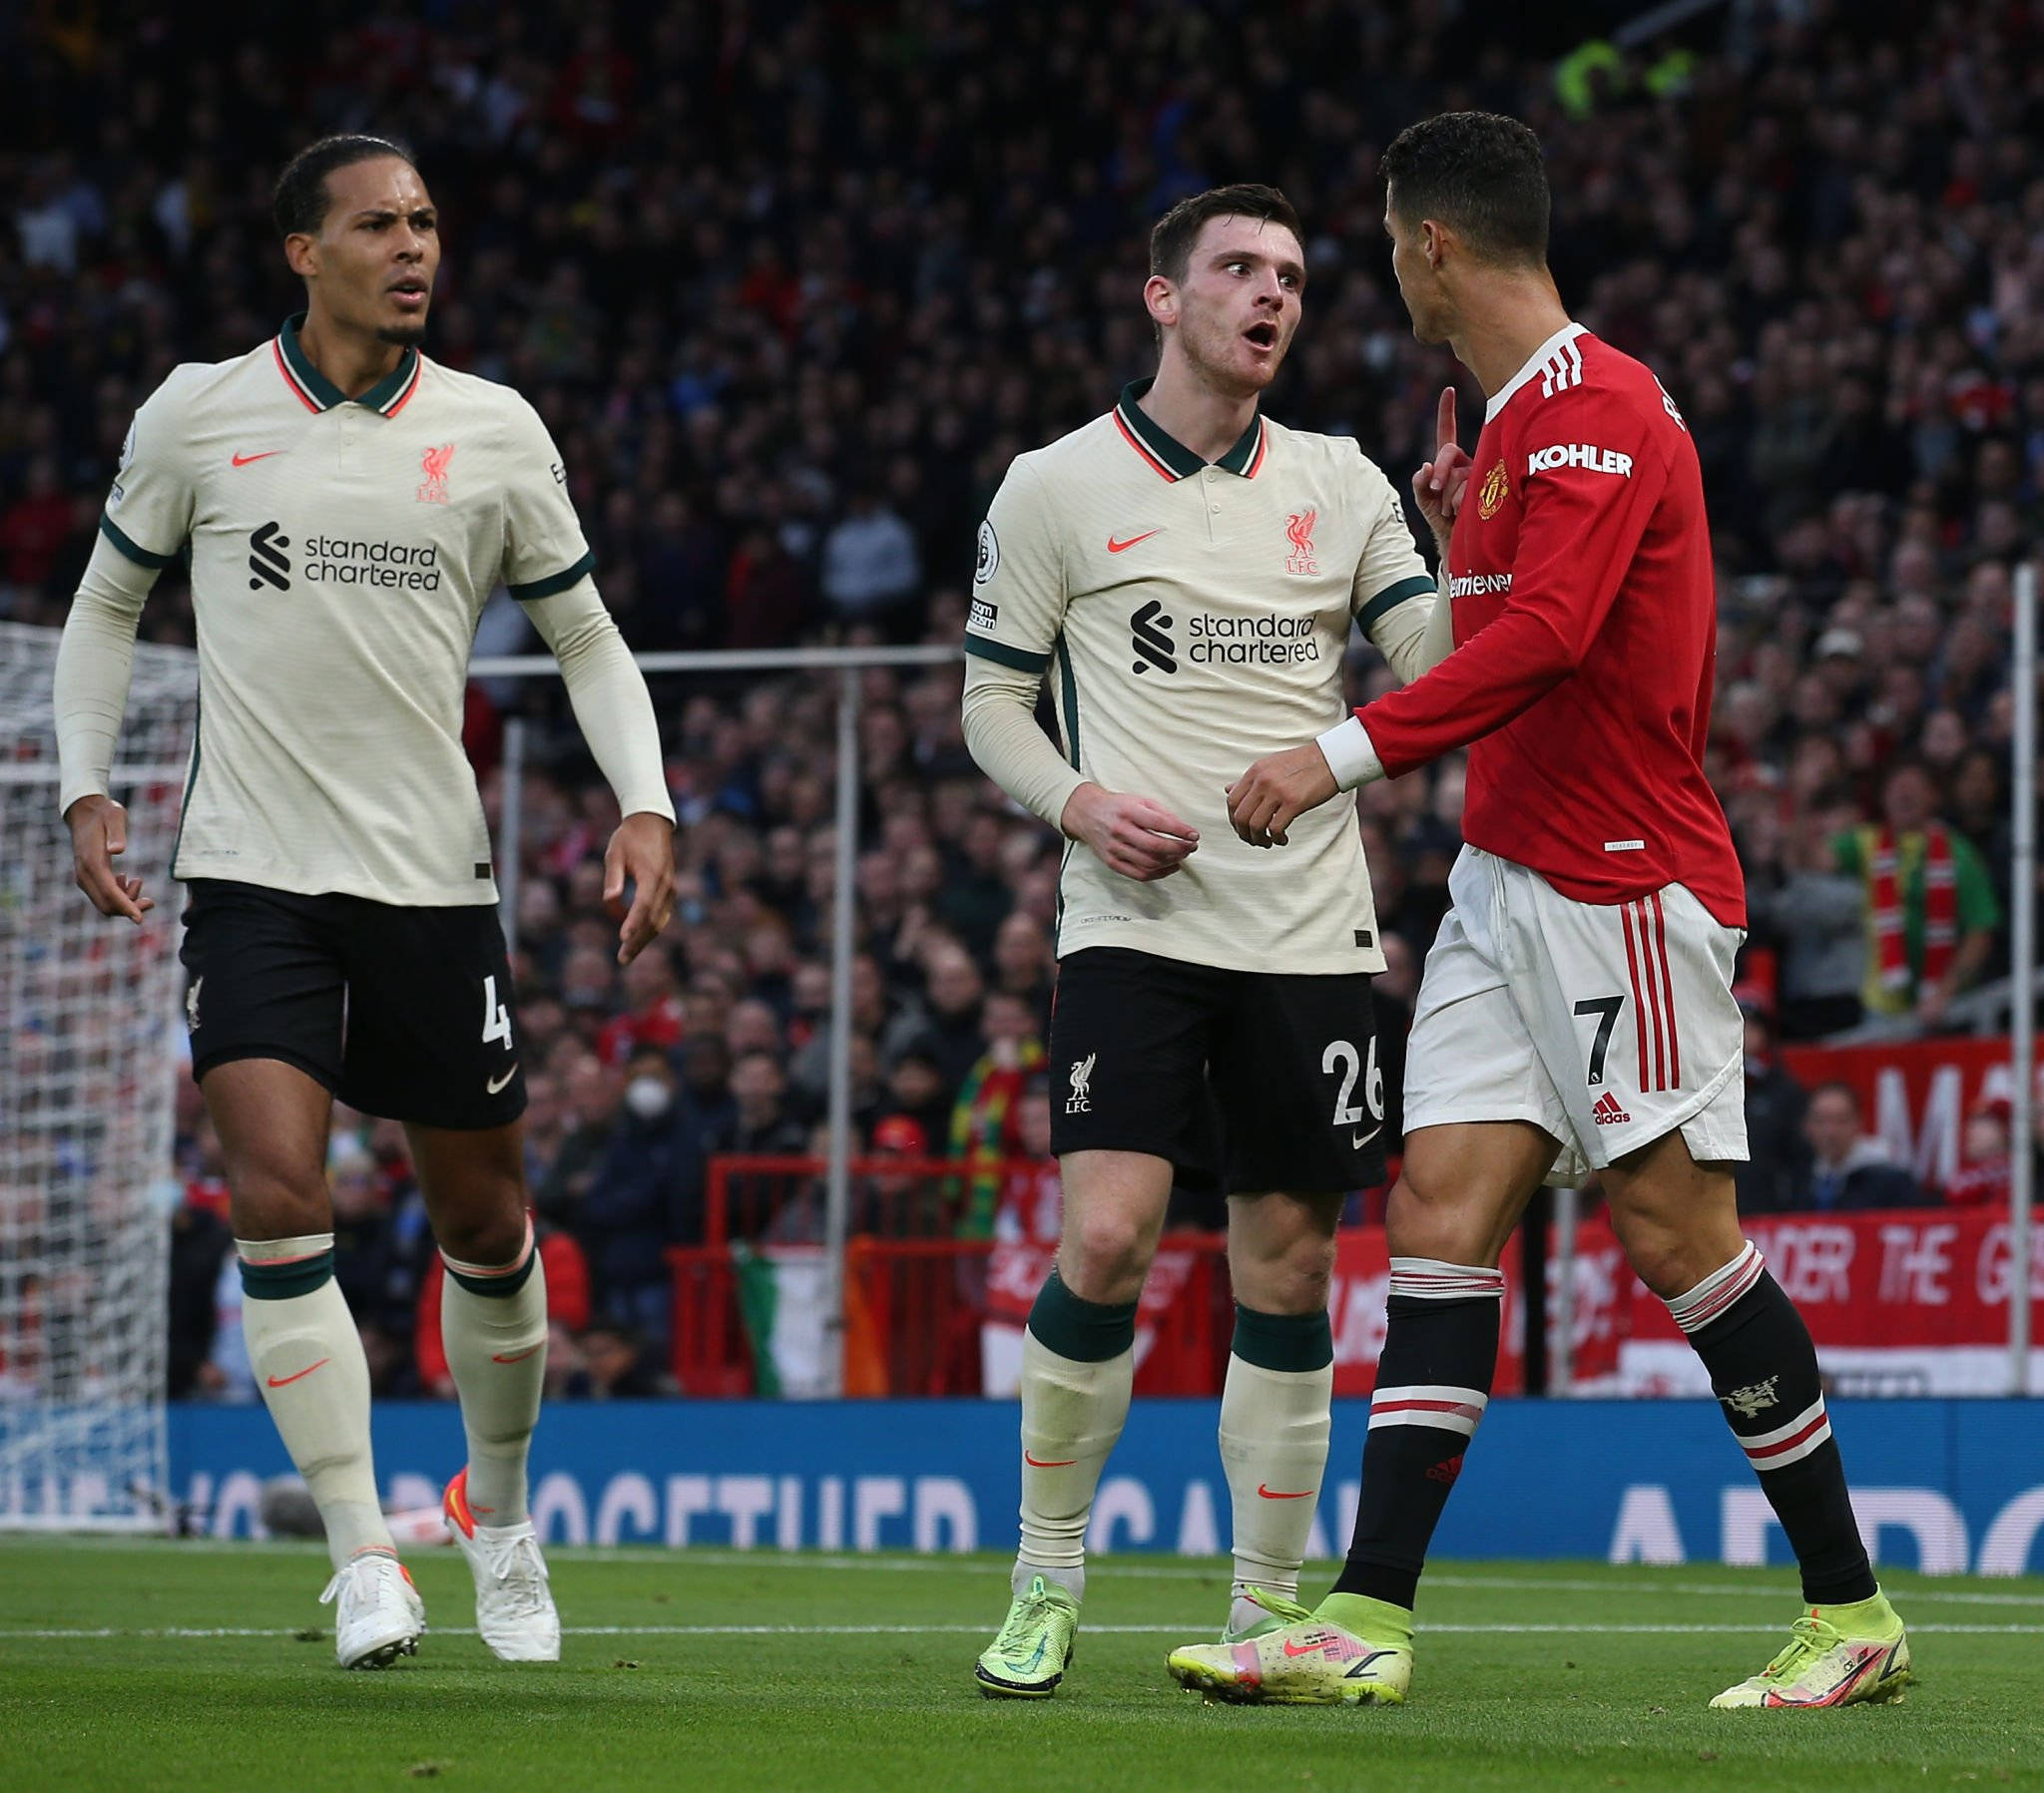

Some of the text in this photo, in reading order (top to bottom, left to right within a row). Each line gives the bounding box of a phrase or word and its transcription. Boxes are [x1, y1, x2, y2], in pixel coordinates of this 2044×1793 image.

[1528, 444, 1633, 479] KOHLER
[304, 535, 437, 567] standard
[304, 560, 440, 592] chartered
[1189, 613, 1316, 640] standard
[1189, 638, 1319, 665] chartered
[482, 975, 512, 1051] 4
[1573, 995, 1626, 1086] 7
[1321, 1035, 1385, 1125] 26
[1595, 1112, 1631, 1125] didas
[1878, 1224, 1958, 1305] THE
